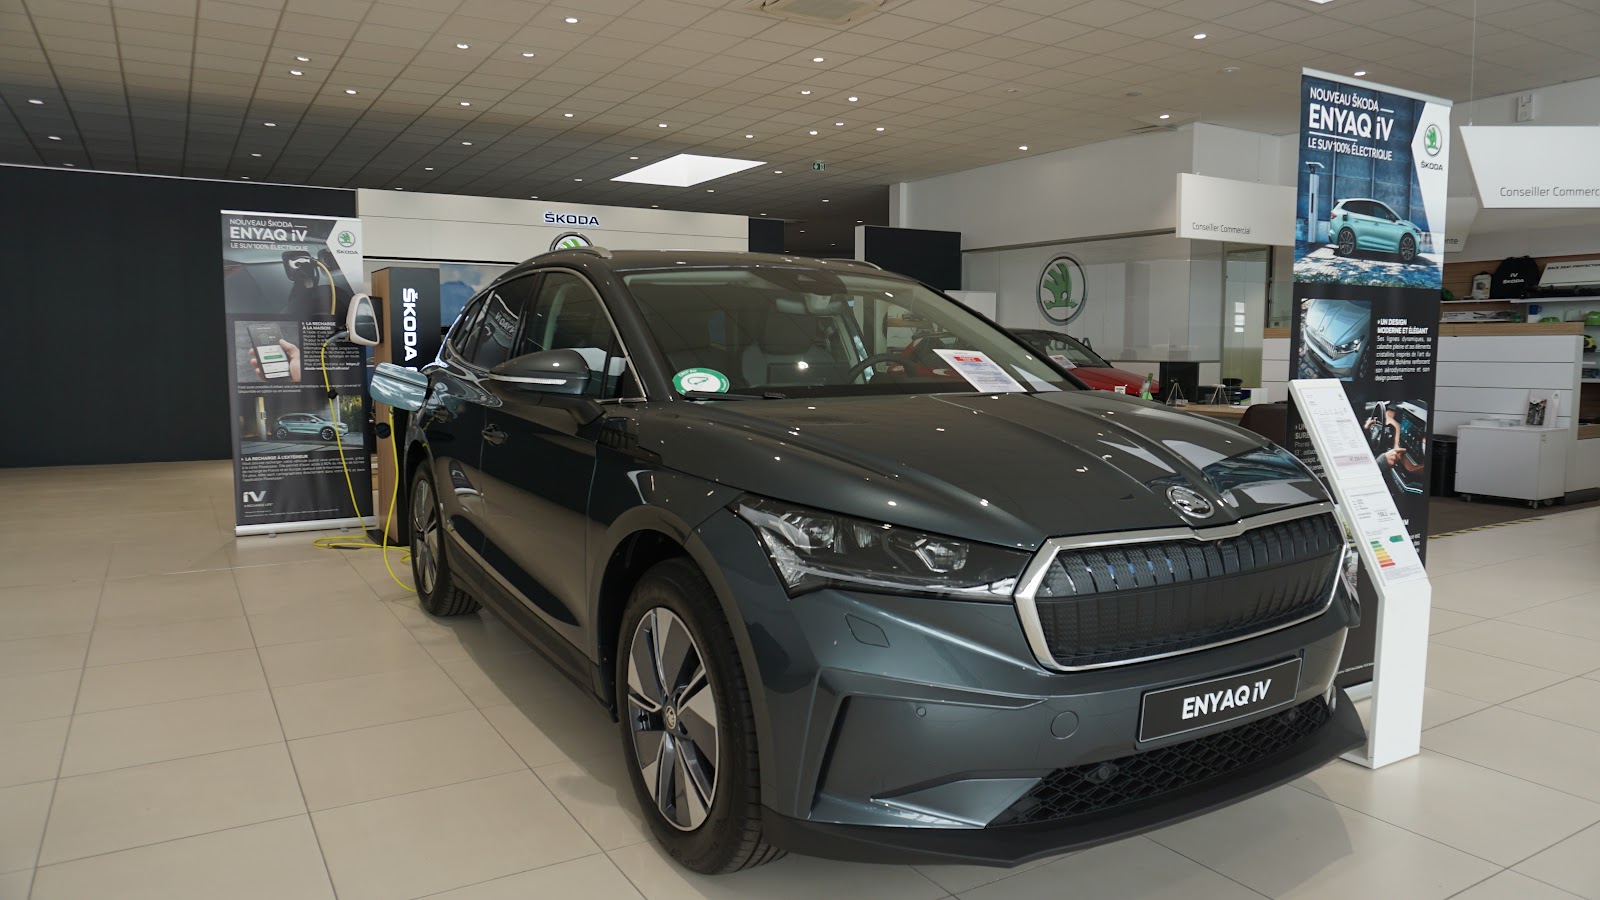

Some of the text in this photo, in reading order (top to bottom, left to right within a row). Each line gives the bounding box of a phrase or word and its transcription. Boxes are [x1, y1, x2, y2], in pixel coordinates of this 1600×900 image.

[1310, 86, 1380, 112] NOUVEAU ŠKODA
[1308, 103, 1394, 142] ENYAQ iV
[1308, 137, 1392, 161] LE SUV 100% ÉLECTRIQUE
[1420, 161, 1443, 171] ŠKODA
[1500, 186, 1600, 196] Conseiller Commerc
[268, 220, 293, 228] ŠKODA
[544, 211, 600, 226] ŠKODA
[230, 226, 308, 242] ENYAQ iV
[1192, 222, 1251, 234] Conseiller Commercial
[403, 288, 418, 361] ŠKODA
[1182, 678, 1272, 720] ENYAQ iV
